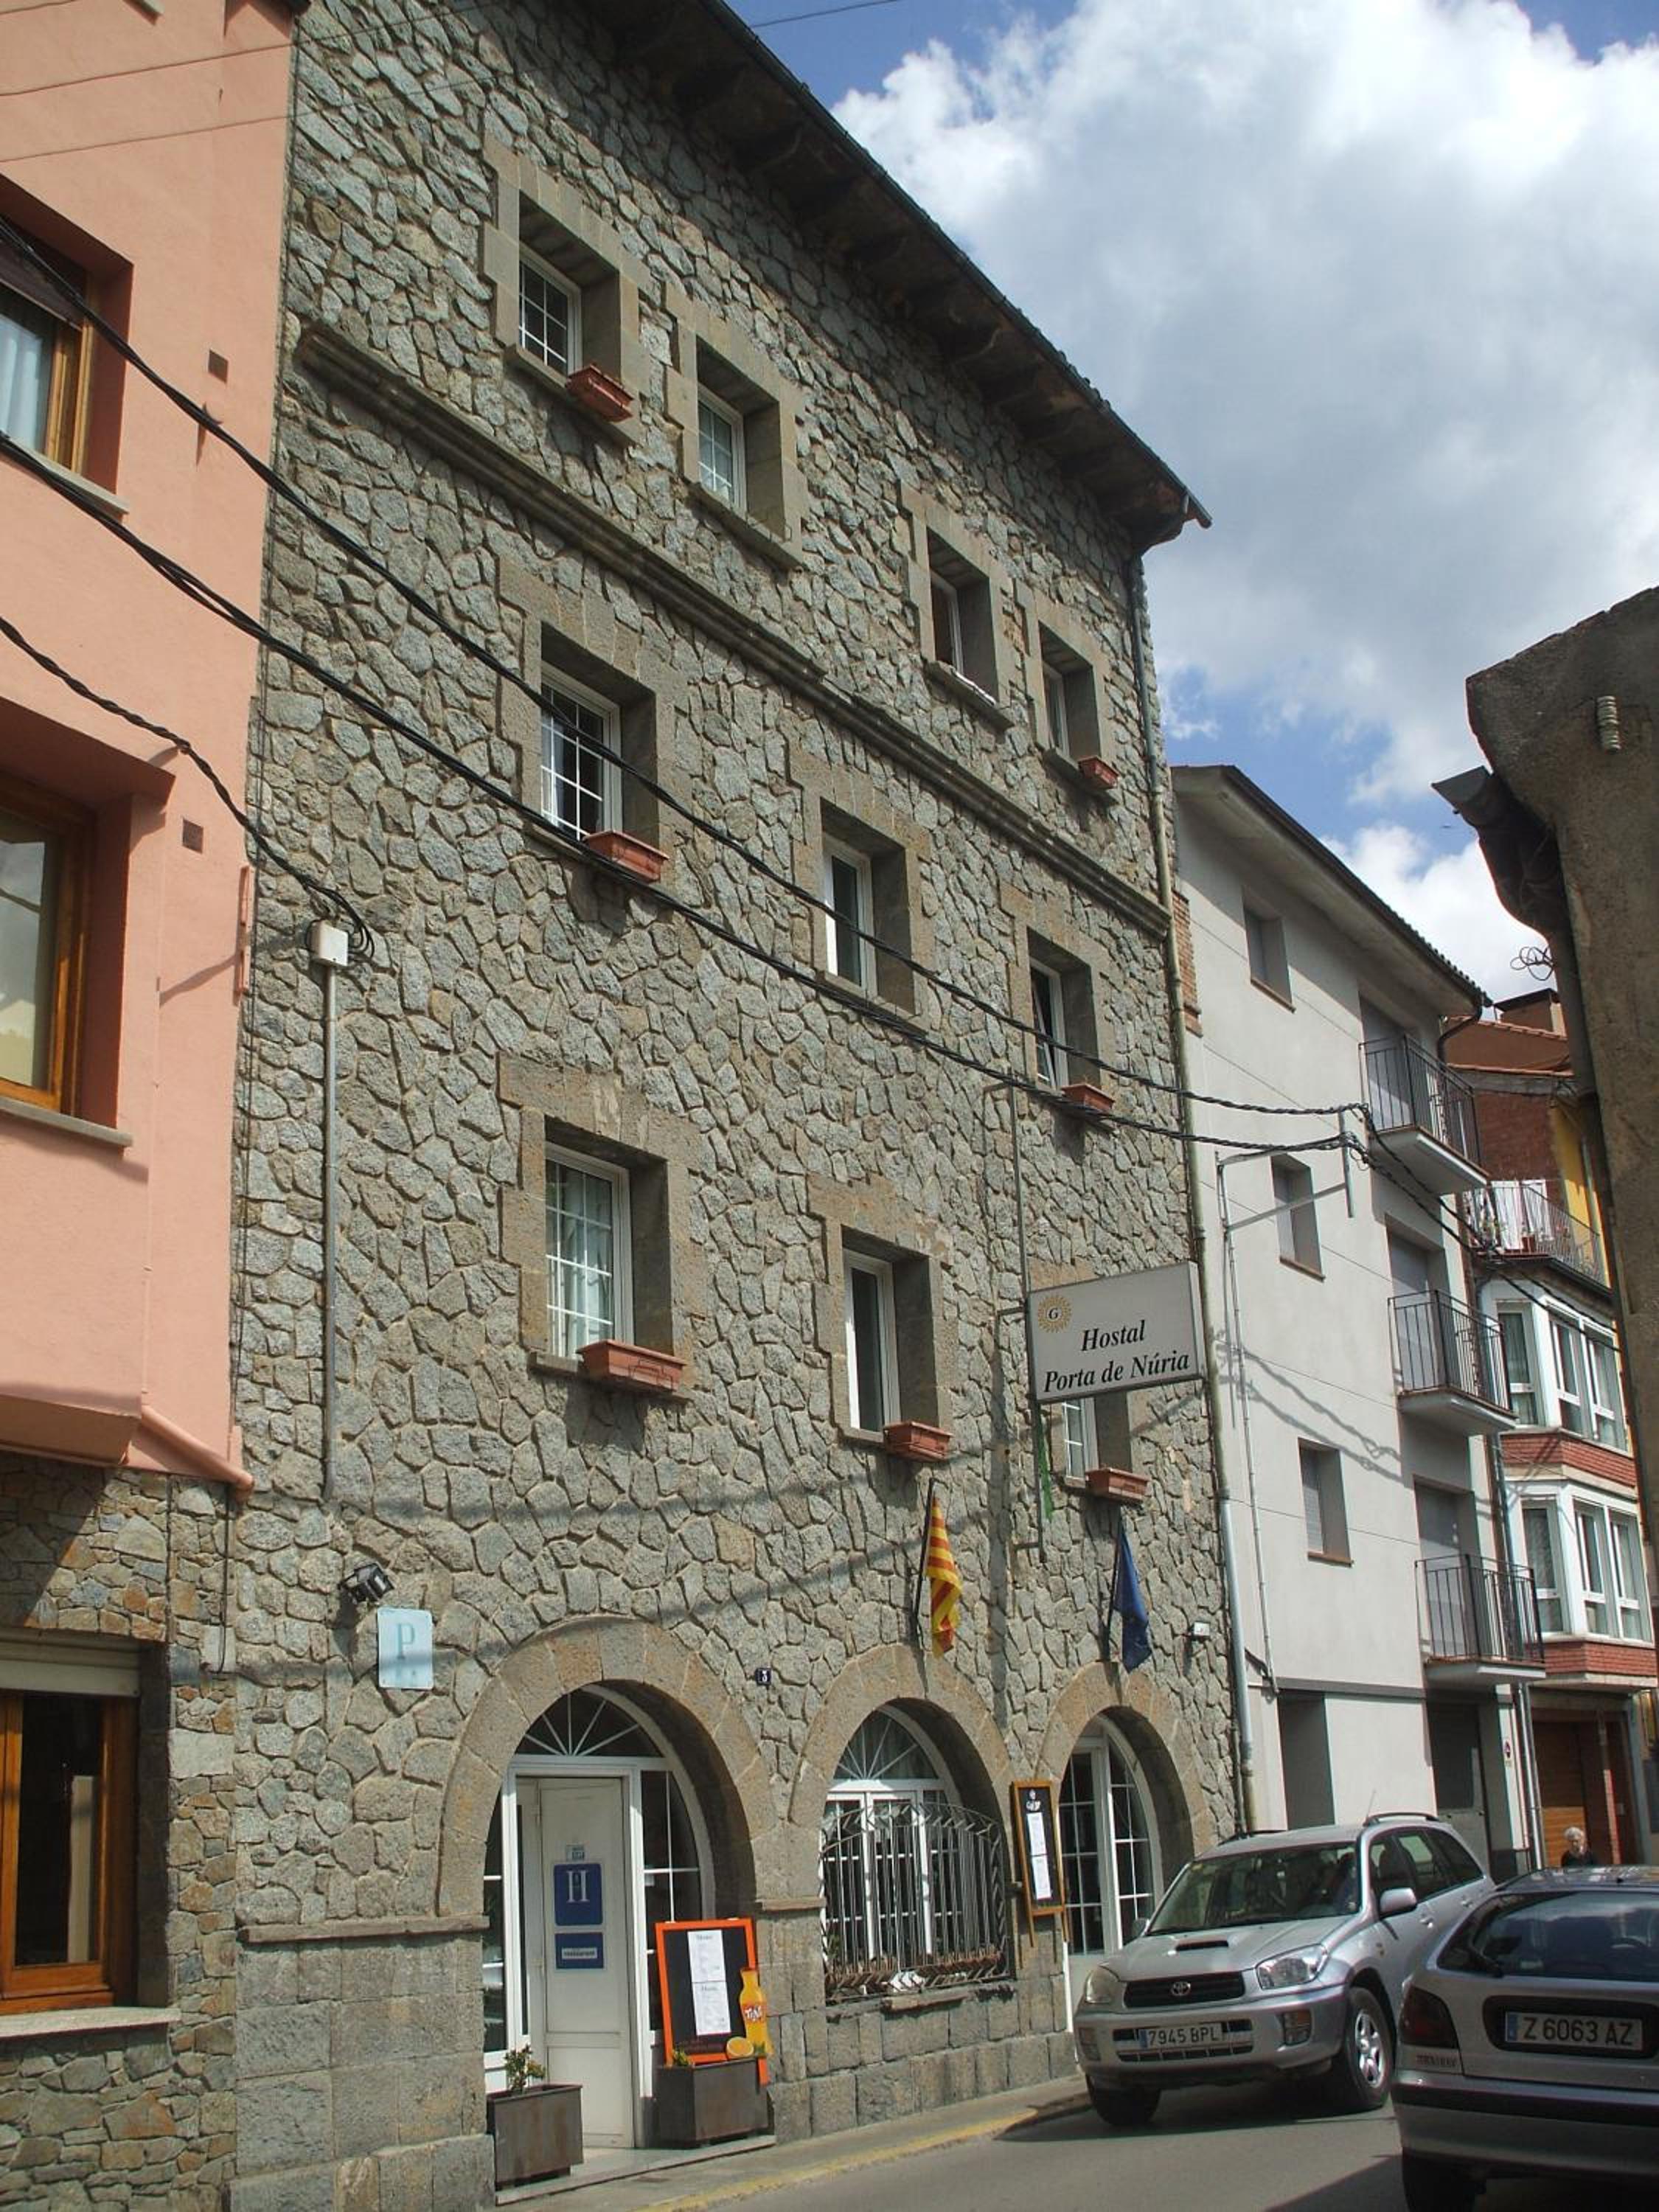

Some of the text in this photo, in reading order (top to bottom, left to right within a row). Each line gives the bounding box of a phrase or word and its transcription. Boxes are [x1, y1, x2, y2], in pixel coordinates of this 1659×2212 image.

[1048, 1308, 1060, 1320] G
[1081, 1320, 1146, 1352] Hostal
[1044, 1350, 1190, 1393] Porta de Núria
[396, 1623, 415, 1660] P
[1148, 2026, 1219, 2046] 7945 BPL
[1523, 2017, 1632, 2046] Z 6063 AZ
